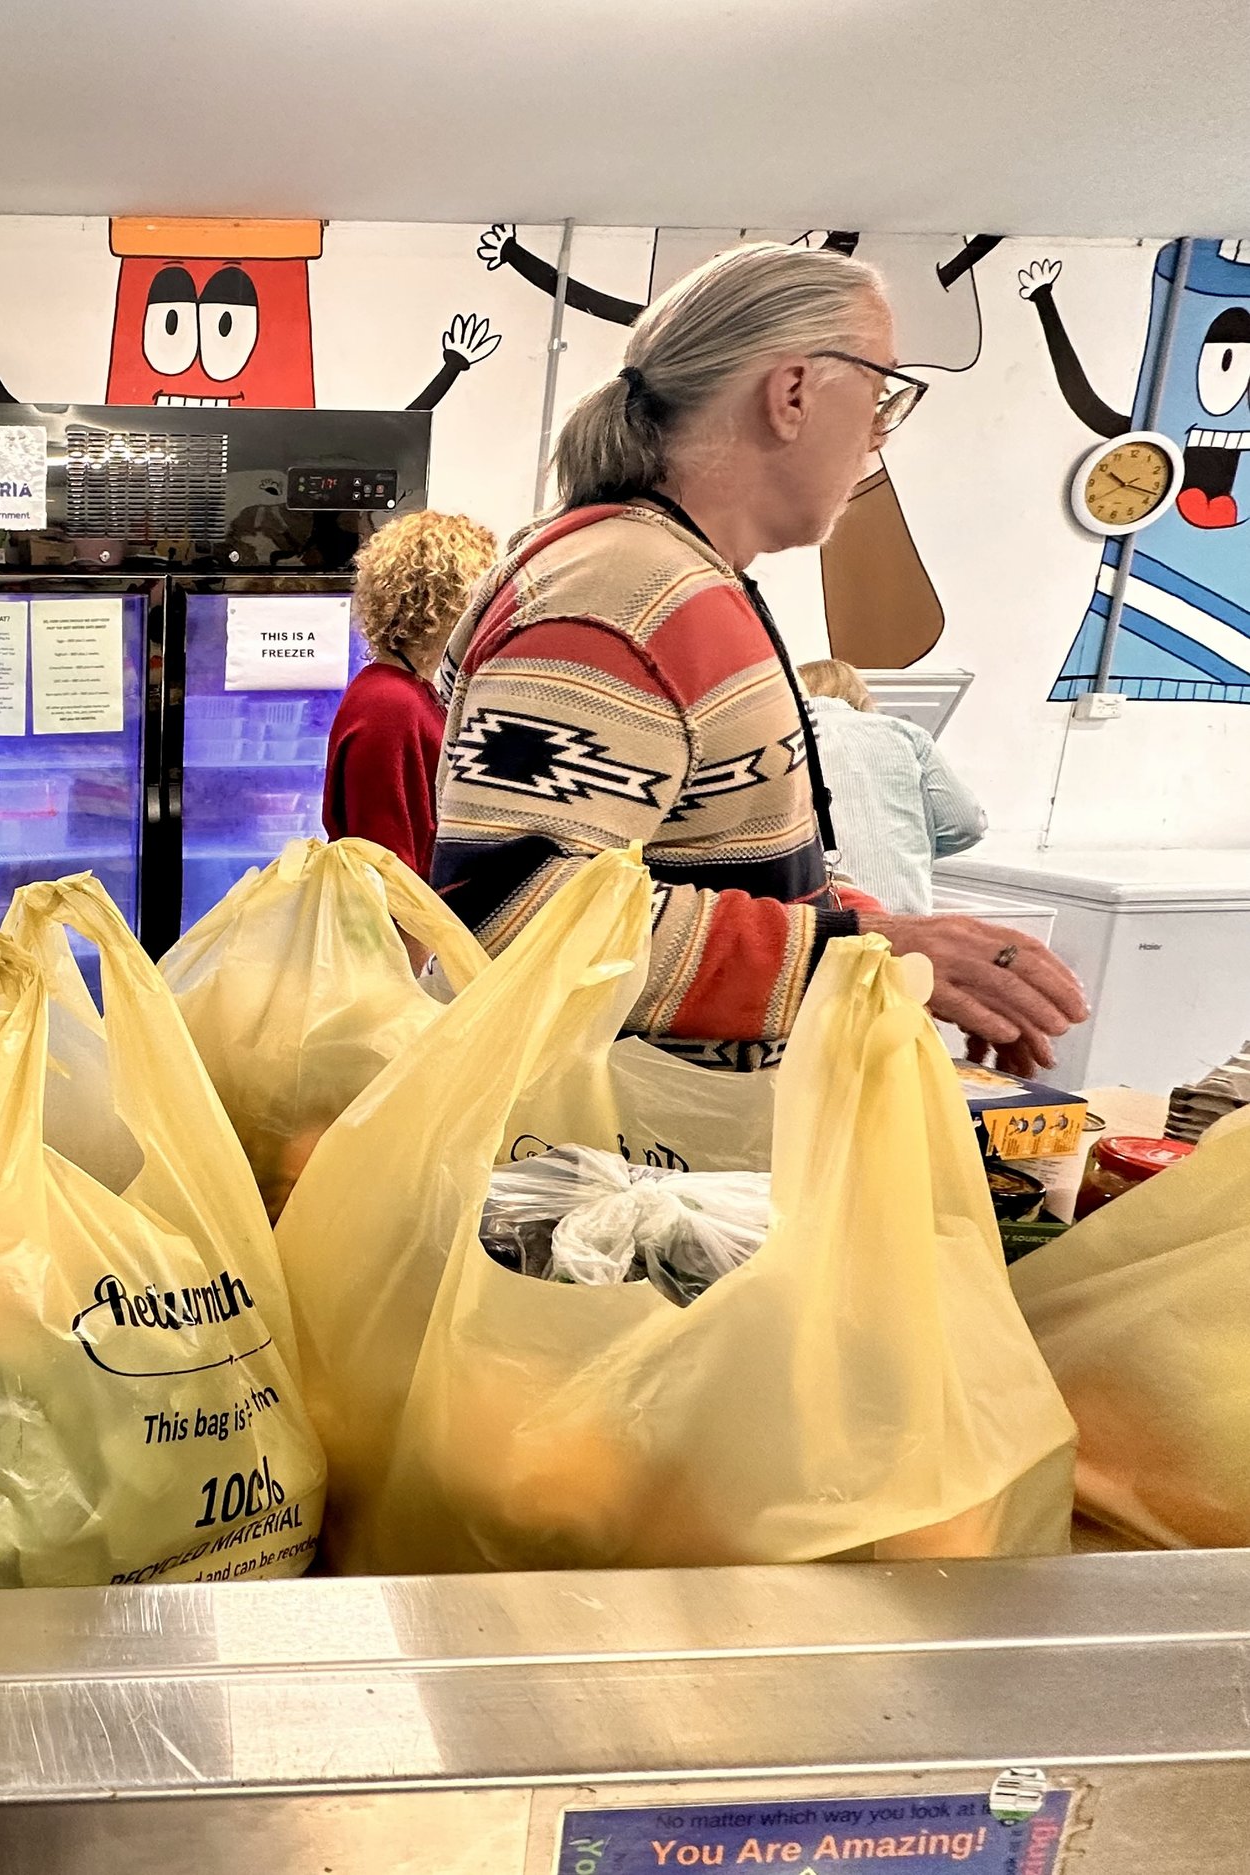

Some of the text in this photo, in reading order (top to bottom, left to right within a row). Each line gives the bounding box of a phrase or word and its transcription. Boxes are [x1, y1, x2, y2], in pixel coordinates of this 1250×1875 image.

[1153, 466, 1161, 475] 2
[260, 632, 315, 641] THIS IS A
[261, 649, 315, 658] FREEZER
[144, 1411, 189, 1444] This
[194, 1407, 230, 1441] bag
[234, 1402, 246, 1432] is
[211, 1503, 303, 1554] MATERIAL
[207, 1561, 231, 1582] and
[233, 1557, 256, 1577] can
[260, 1550, 275, 1567] be
[655, 1815, 684, 1829] No
[691, 1813, 752, 1829] matter
[760, 1808, 816, 1827] which
[822, 1809, 862, 1827] way
[869, 1807, 904, 1825] you
[911, 1802, 950, 1820] look
[955, 1802, 975, 1817] at
[651, 1826, 988, 1866] You Are Amazing!
